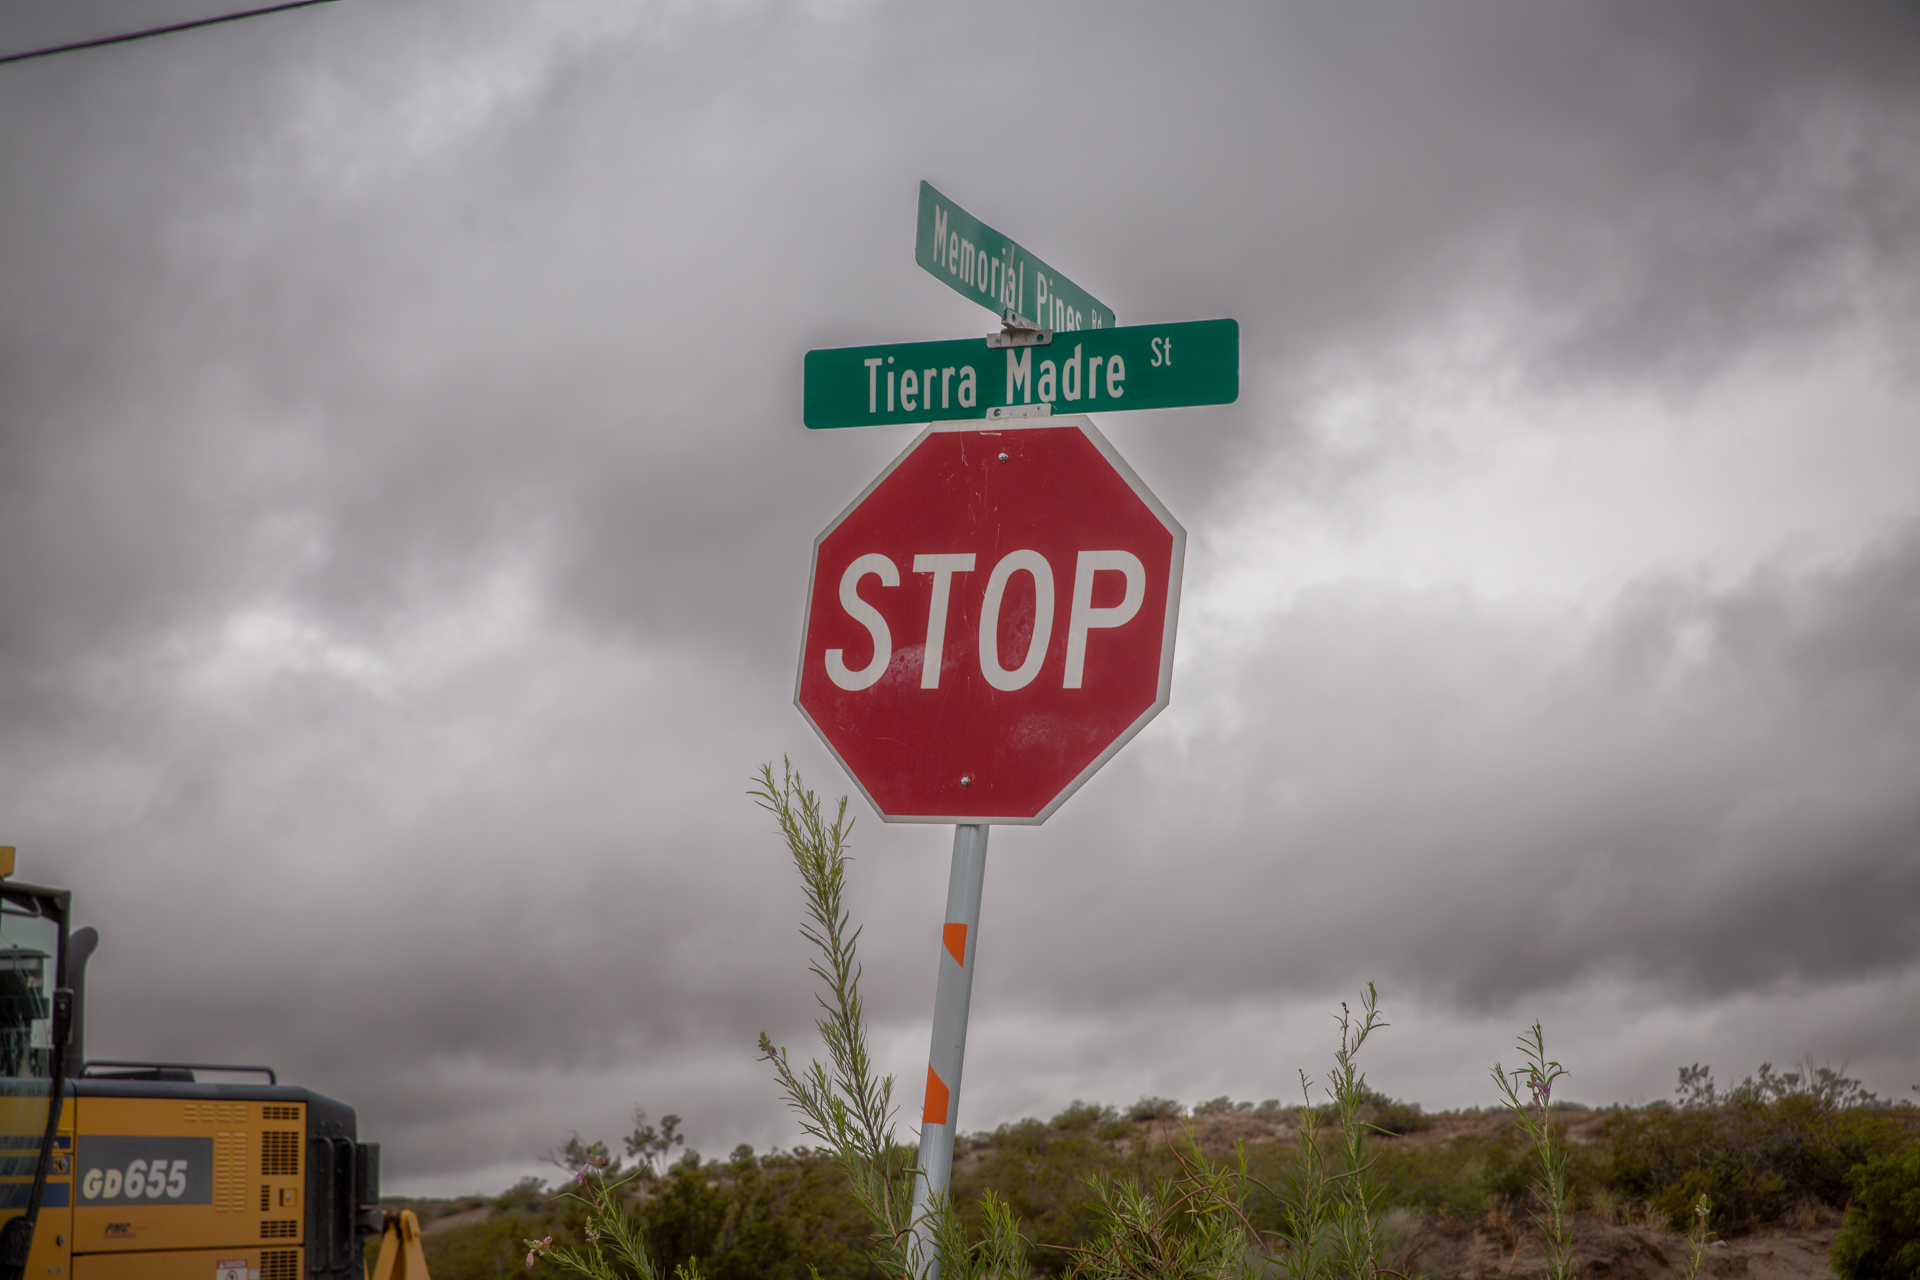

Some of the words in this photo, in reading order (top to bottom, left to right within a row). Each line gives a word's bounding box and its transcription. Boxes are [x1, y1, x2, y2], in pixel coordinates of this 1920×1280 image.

[933, 204, 1024, 315] Memorial
[1037, 271, 1082, 333] Pines
[1091, 308, 1102, 330] Rd
[864, 356, 977, 413] Tierra
[1006, 343, 1126, 405] Madre
[1150, 336, 1172, 367] St
[824, 549, 1146, 692] STOP
[82, 1159, 188, 1199] GD655
